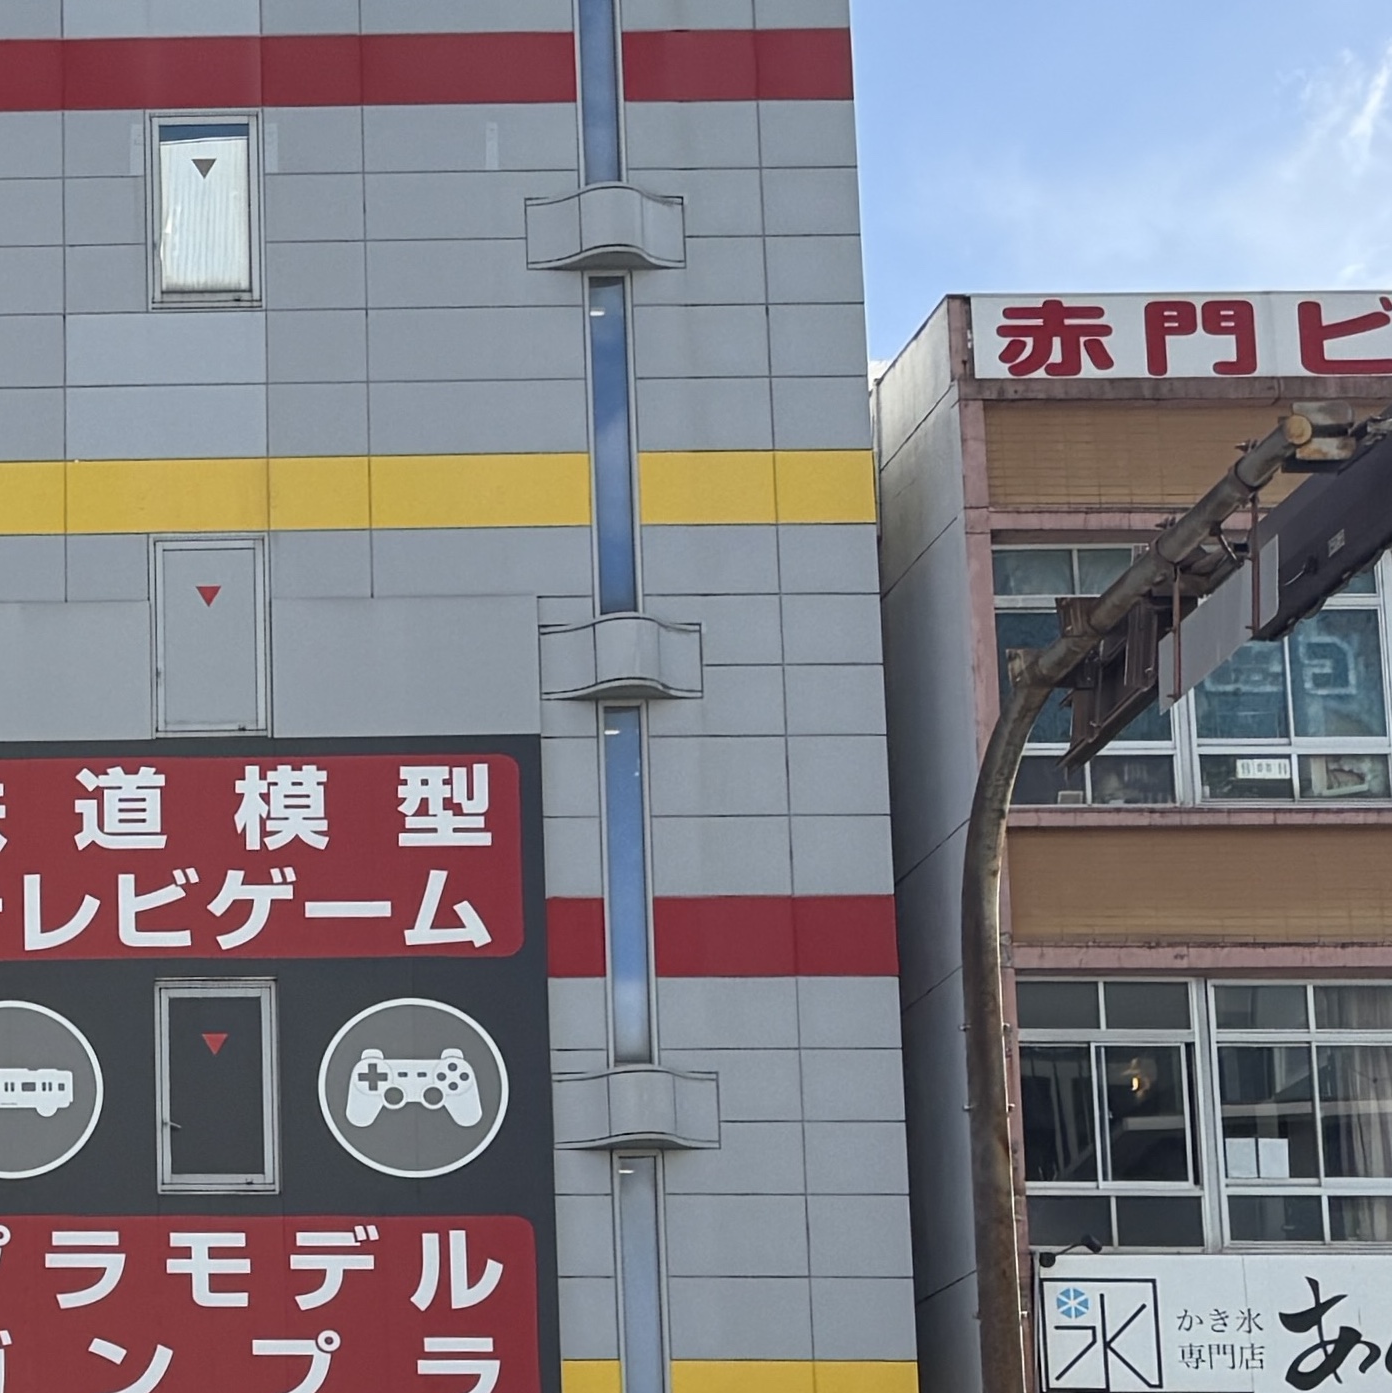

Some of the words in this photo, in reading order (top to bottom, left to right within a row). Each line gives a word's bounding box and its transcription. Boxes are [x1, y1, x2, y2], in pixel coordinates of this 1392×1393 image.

[1176, 1309, 1264, 1333] かき氷
[1178, 1343, 1265, 1371] 専門店
